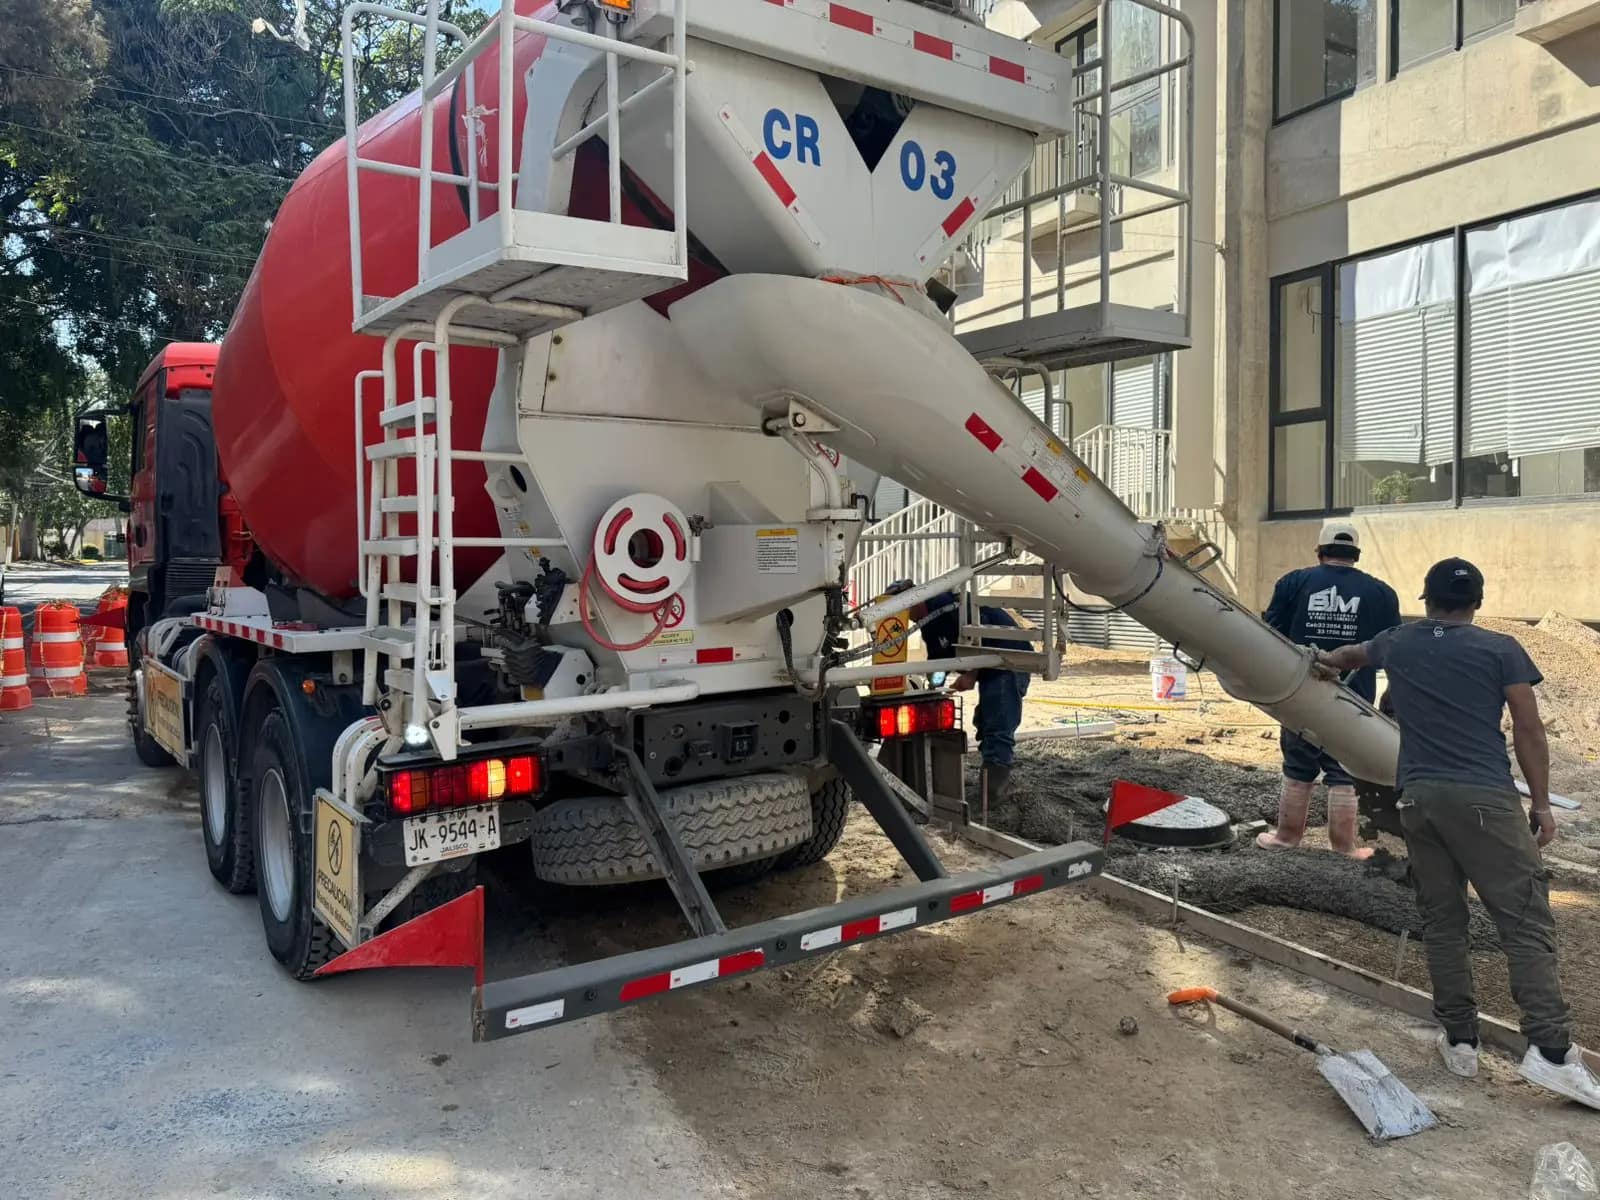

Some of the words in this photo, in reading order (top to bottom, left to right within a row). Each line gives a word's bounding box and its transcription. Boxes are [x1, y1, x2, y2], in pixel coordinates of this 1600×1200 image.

[763, 108, 821, 167] CR
[900, 140, 956, 200] 03
[409, 815, 496, 851] JK-9544-A
[440, 843, 468, 853] JALISCO
